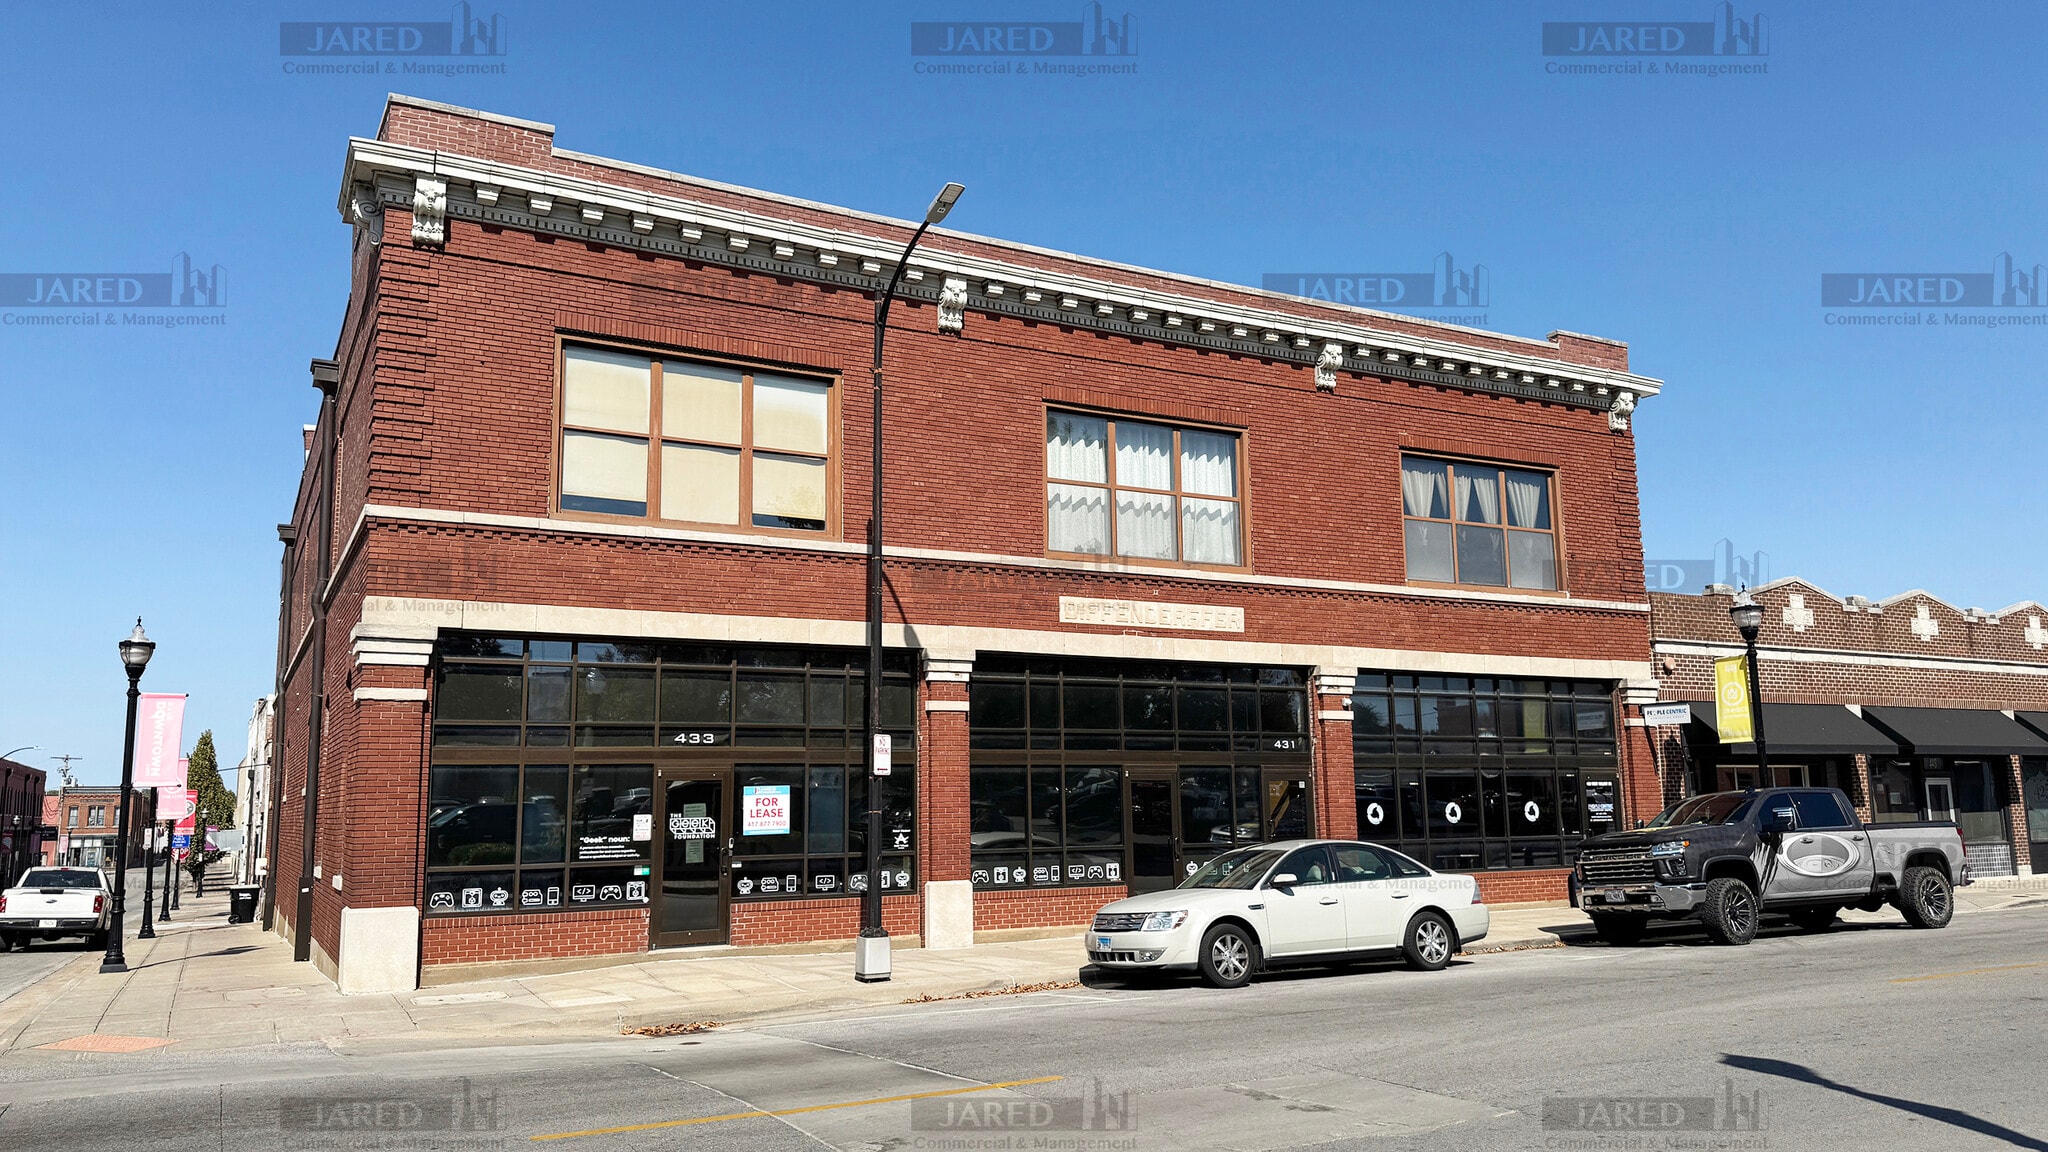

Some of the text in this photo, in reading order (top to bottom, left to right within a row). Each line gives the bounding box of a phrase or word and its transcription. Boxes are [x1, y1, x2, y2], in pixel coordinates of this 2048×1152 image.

[1065, 602, 1241, 629] DIFFENDERFFER
[150, 701, 167, 777] DOWNTOWN
[674, 733, 714, 743] 433
[1274, 740, 1295, 749] 431
[756, 797, 778, 807] FOR
[750, 808, 783, 818] LEASE
